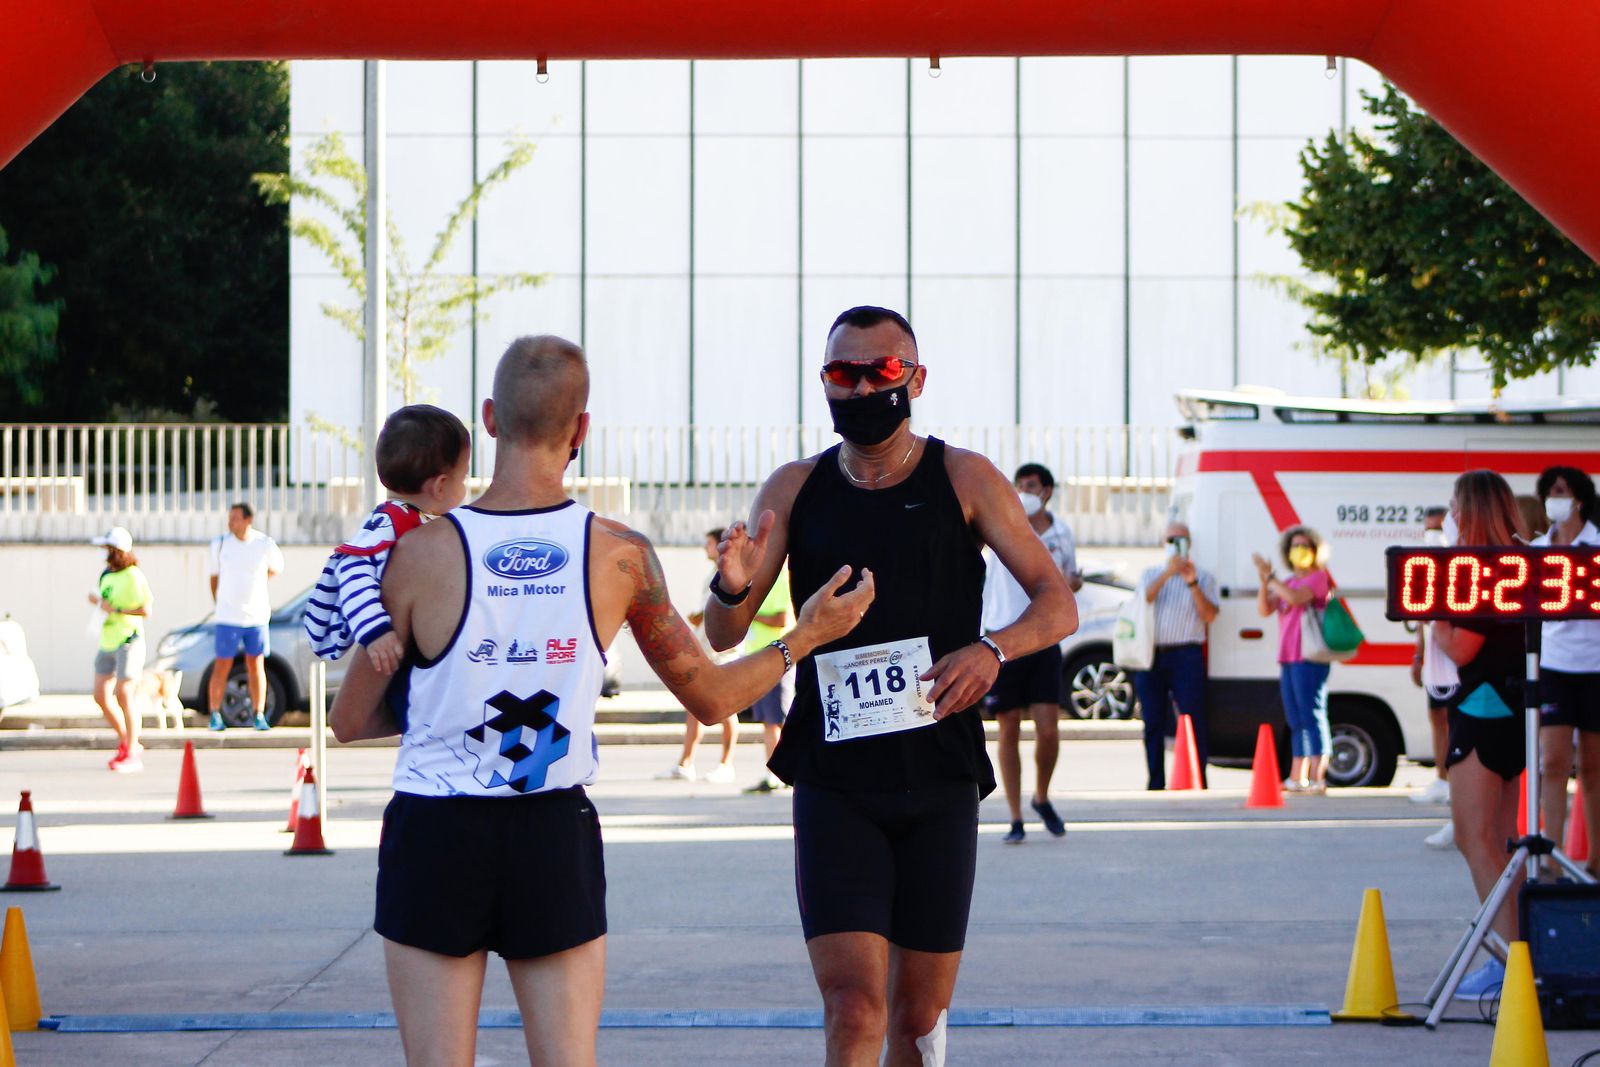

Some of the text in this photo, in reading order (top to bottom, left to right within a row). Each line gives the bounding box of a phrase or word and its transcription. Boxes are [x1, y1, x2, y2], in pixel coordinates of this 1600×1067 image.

[1337, 505, 1369, 522] 958
[1376, 505, 1408, 523] 222
[498, 545, 552, 572] Ford
[487, 583, 566, 597] Mica Motor
[546, 638, 577, 651] ALS
[845, 666, 906, 699] 118
[859, 698, 893, 709] MOHAMED
